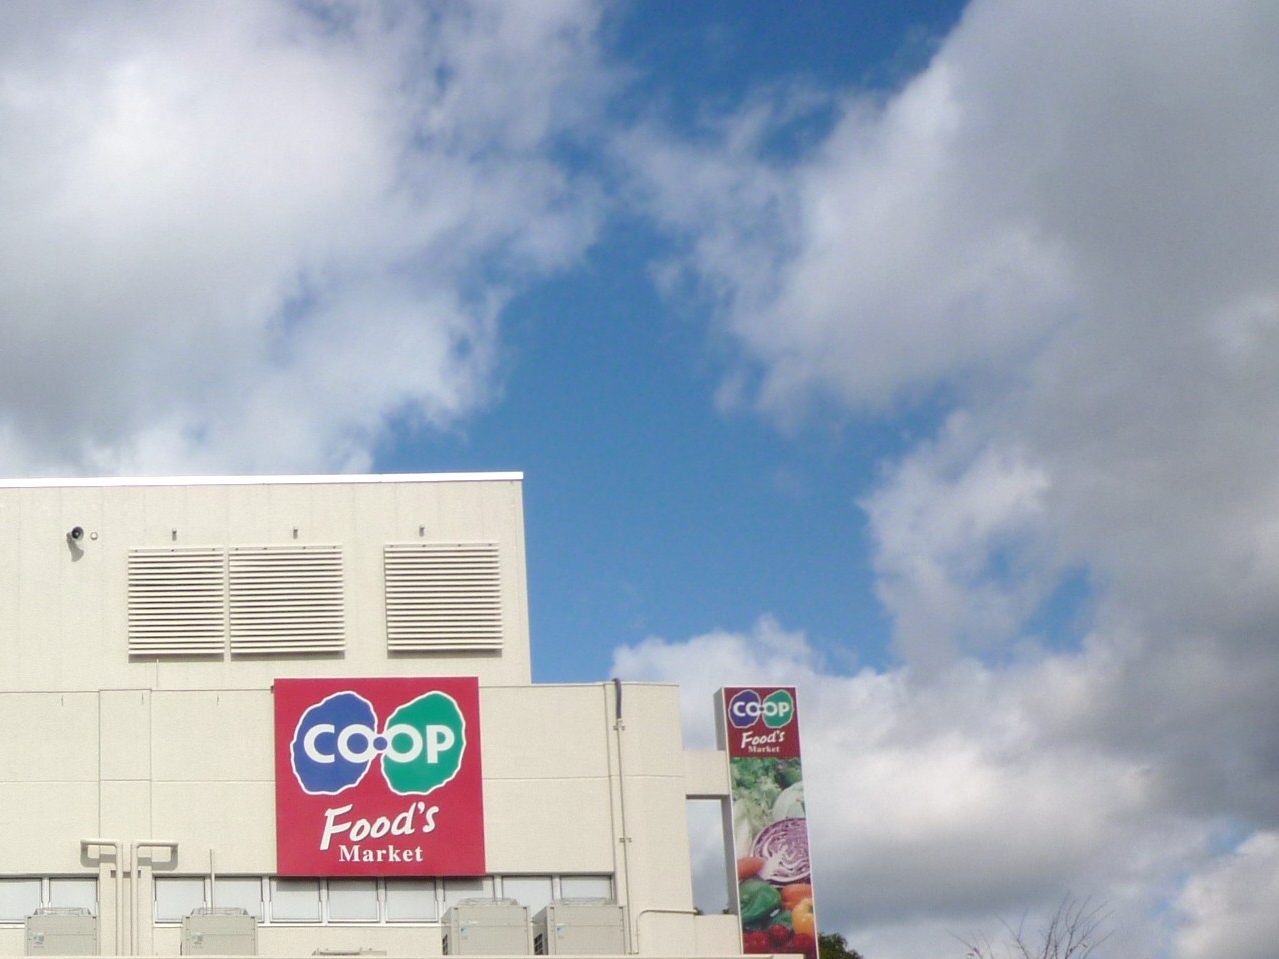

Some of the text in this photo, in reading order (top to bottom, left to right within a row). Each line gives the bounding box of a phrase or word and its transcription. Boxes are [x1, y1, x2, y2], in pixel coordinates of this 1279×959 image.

[741, 730, 786, 748] Food's
[320, 801, 440, 850] Food's
[338, 844, 424, 862] Market
